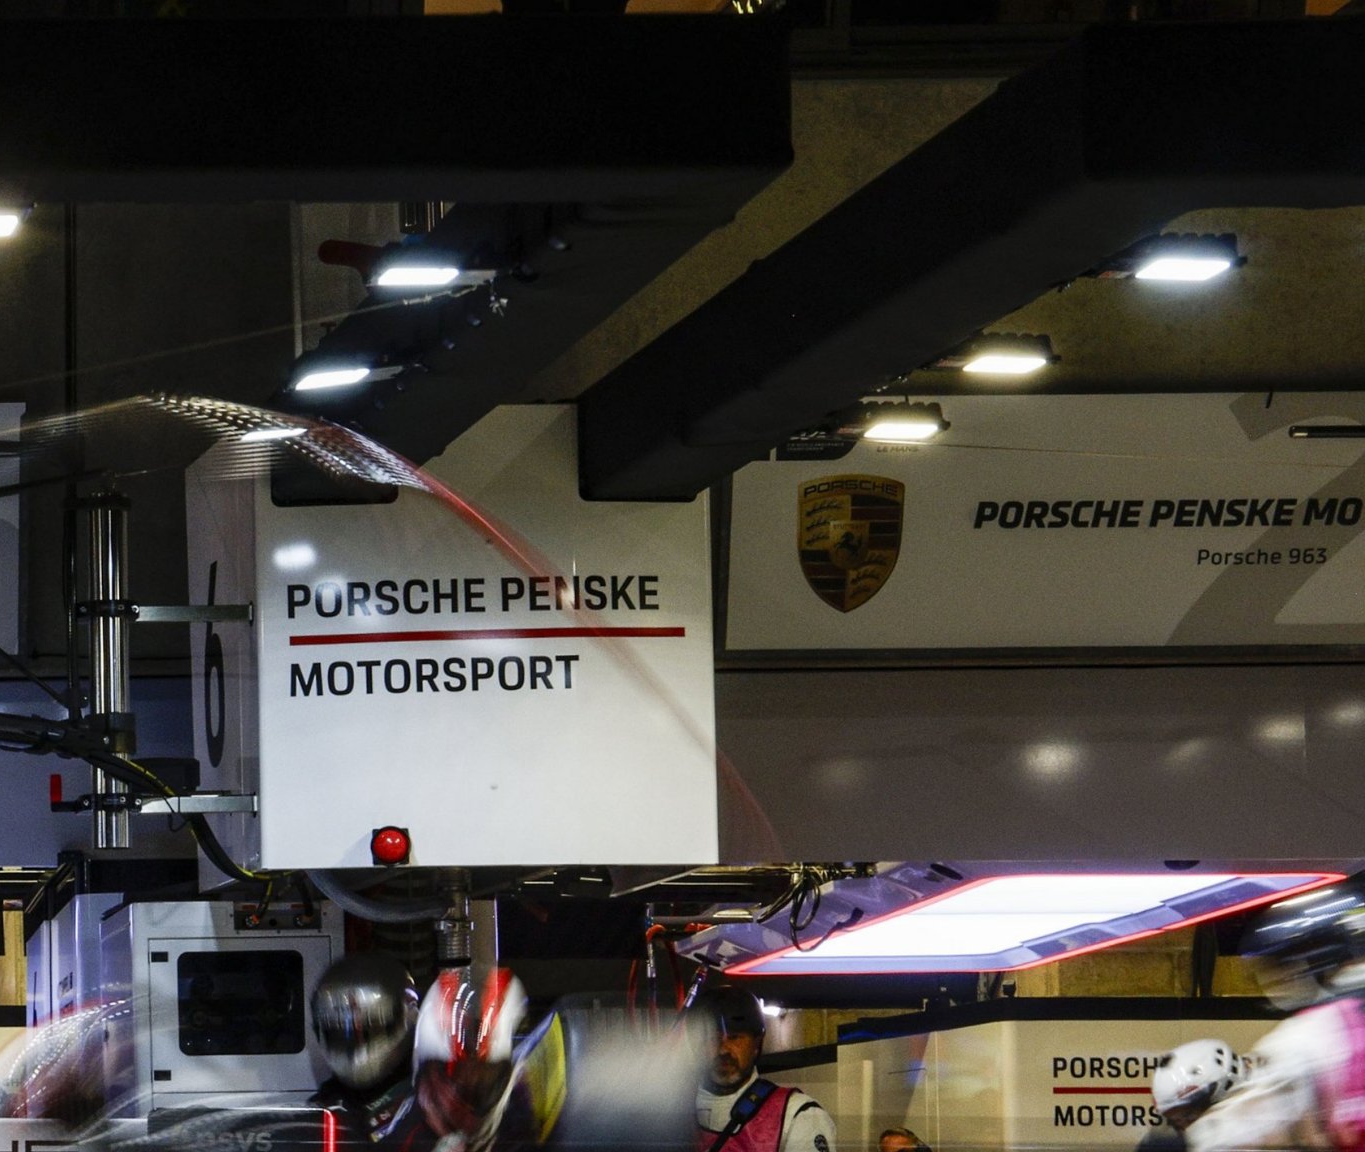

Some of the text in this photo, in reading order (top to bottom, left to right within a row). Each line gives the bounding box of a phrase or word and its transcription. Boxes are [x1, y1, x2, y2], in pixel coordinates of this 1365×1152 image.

[804, 480, 898, 497] PORSCHE
[974, 501, 1144, 530] PORSCHE
[1149, 499, 1294, 528] PENSKE
[1197, 548, 1329, 566] Porsche 963
[287, 575, 661, 619] PORSCHE PENSKE
[289, 654, 580, 698] MOTORSPORT
[1053, 1057, 1160, 1079] PORSCH
